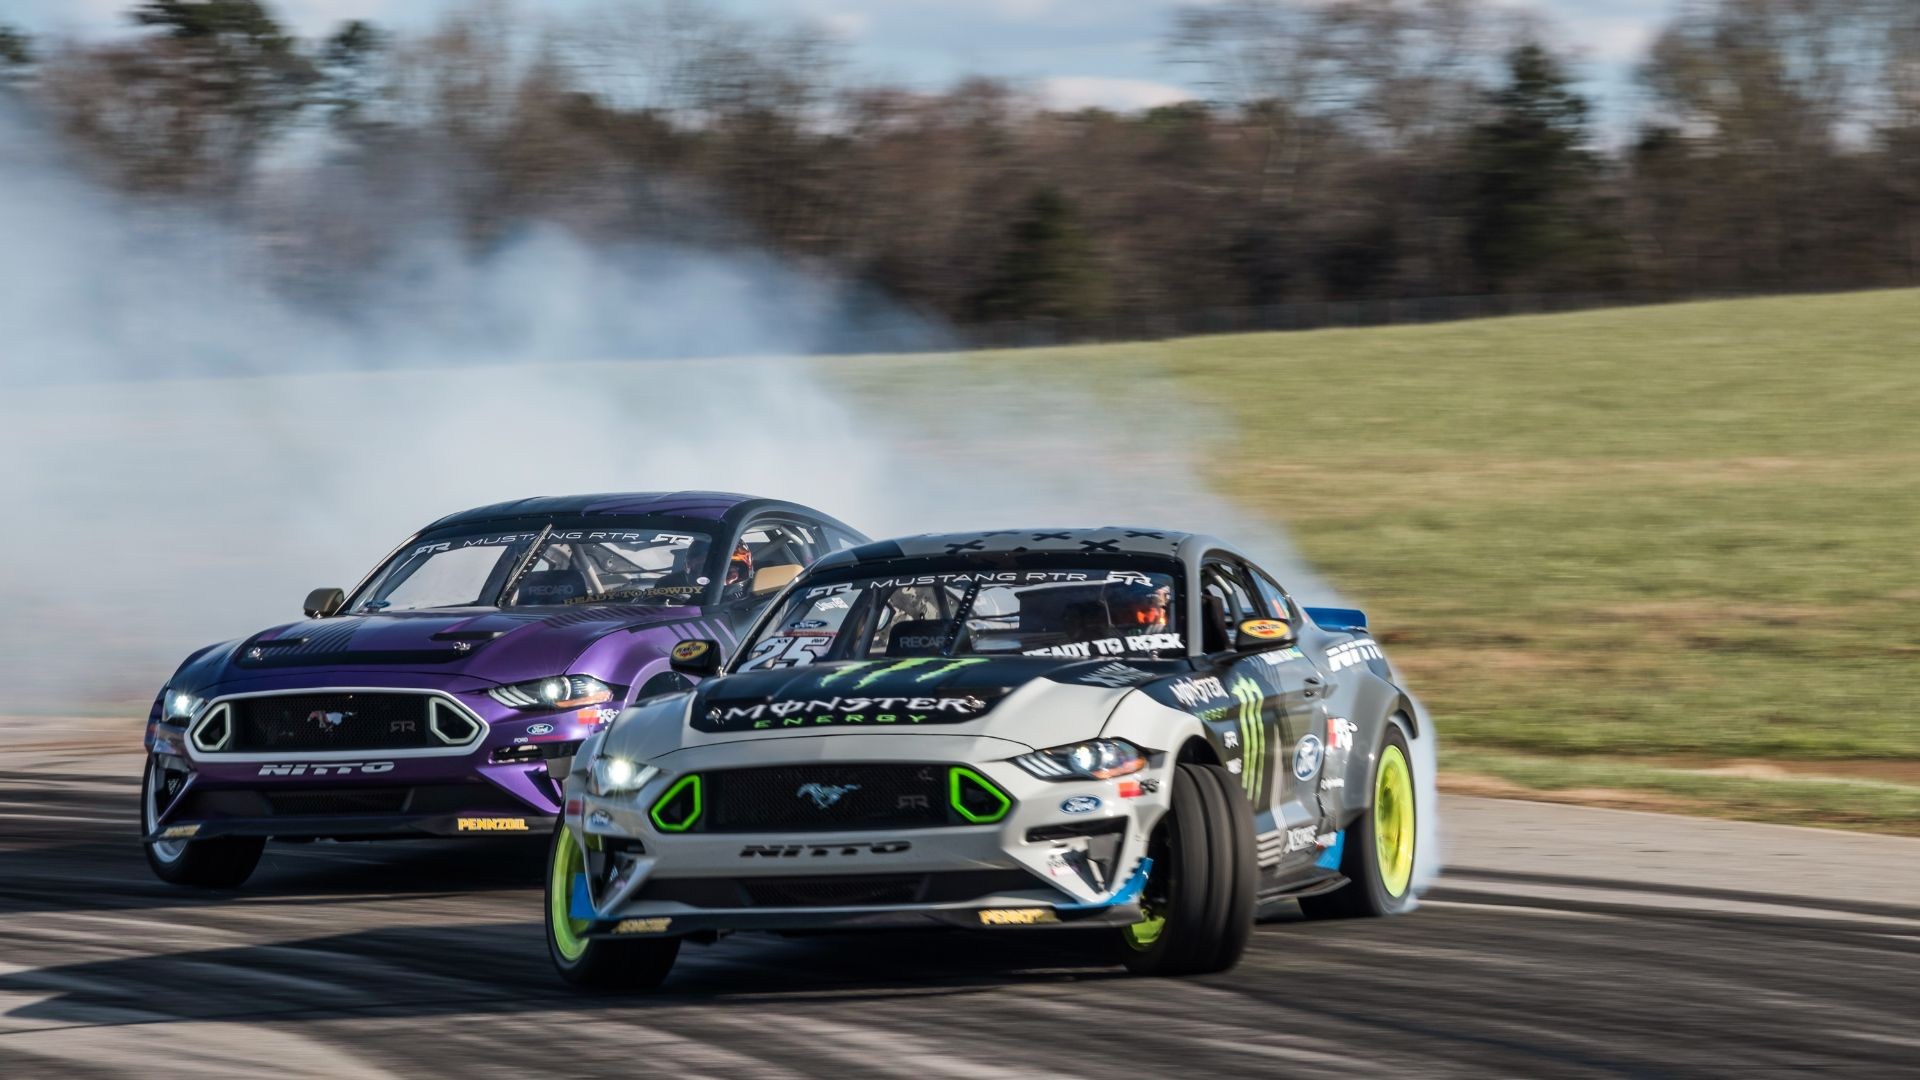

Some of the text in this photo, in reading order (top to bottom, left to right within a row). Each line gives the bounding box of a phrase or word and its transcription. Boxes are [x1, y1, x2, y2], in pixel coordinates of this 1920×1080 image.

[588, 532, 640, 540] RTR
[870, 572, 1087, 589] MUSTANG RTR
[528, 584, 574, 596] RECARO
[563, 586, 703, 605] READY TO ROWDY
[898, 635, 948, 649] RECAR
[1092, 638, 1125, 654] TO
[1125, 633, 1185, 652] ROCK
[753, 714, 928, 729] ENERGY
[257, 761, 395, 776] NITTO
[457, 817, 529, 831] PENNZOIL
[739, 840, 912, 858] NITTO
